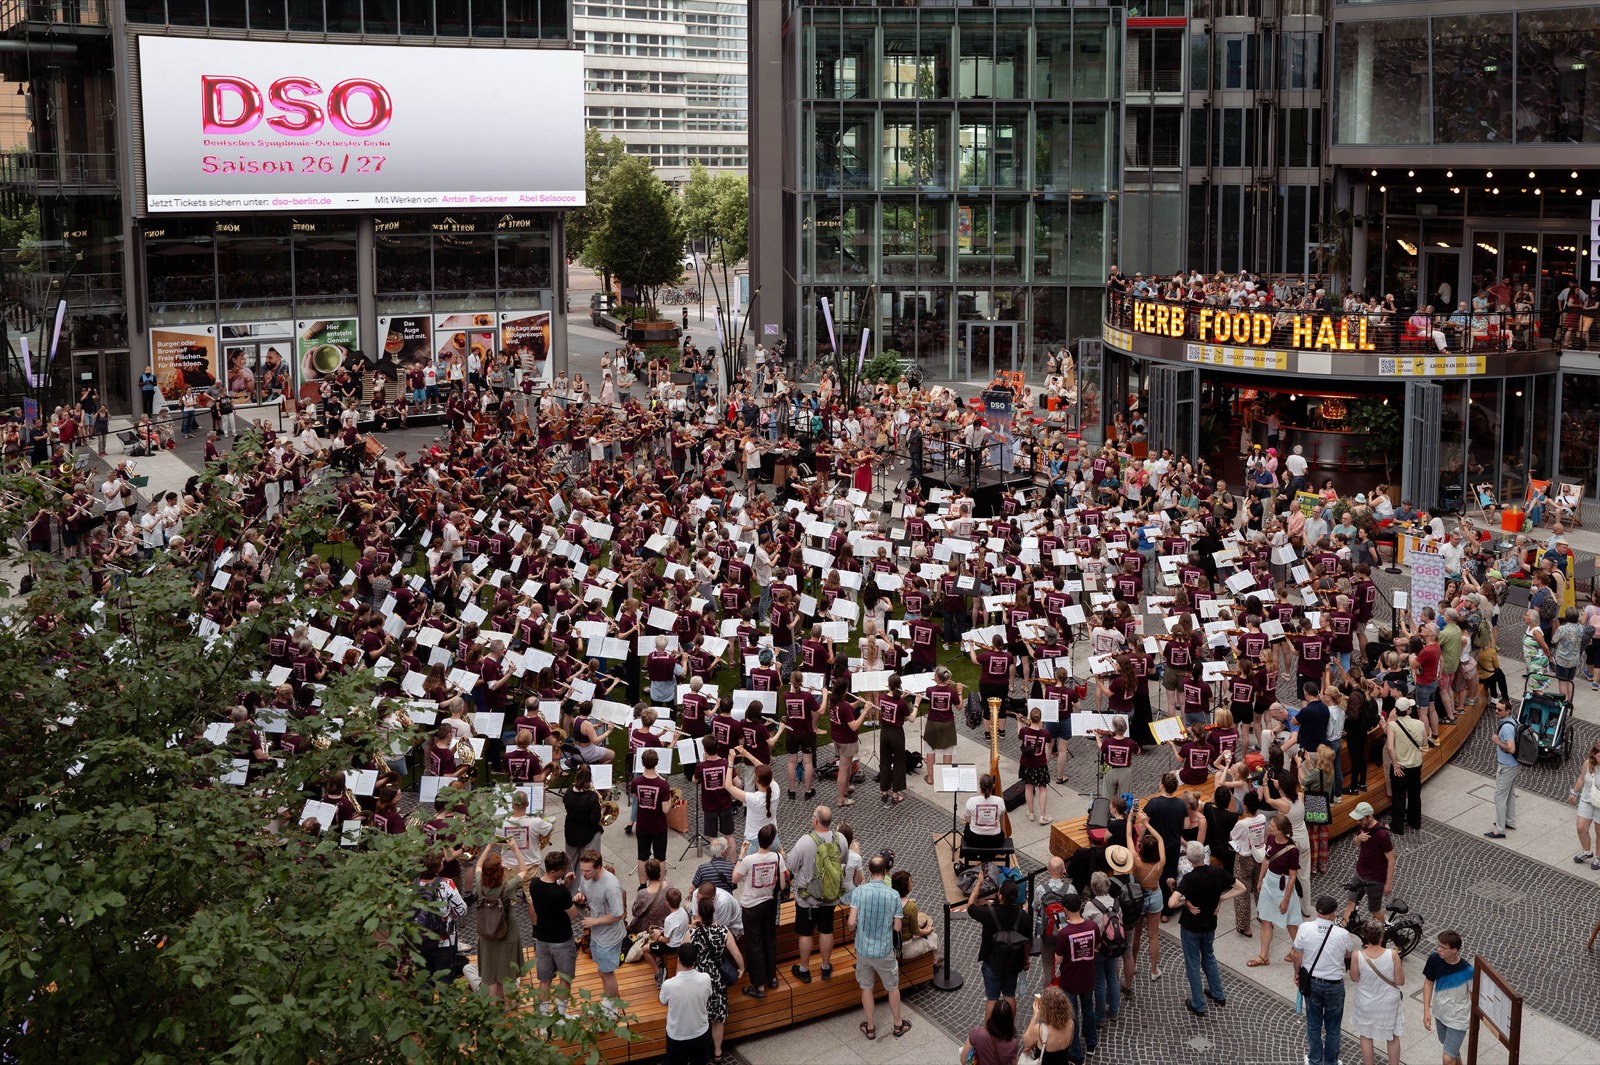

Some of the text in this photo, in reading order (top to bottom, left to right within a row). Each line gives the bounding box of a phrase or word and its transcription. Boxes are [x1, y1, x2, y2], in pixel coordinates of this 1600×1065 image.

[201, 74, 393, 136] DSO
[202, 153, 387, 176] Saison 26 / 27
[149, 198, 173, 208] Jetzt
[174, 198, 207, 207] Tickets
[208, 198, 242, 207] sichern
[244, 198, 270, 206] unter:
[272, 197, 332, 206] dso-berlin.de
[374, 196, 389, 204] Mit
[391, 195, 421, 204] Werken
[441, 195, 468, 203] Anton
[469, 195, 508, 203] Bruckner
[519, 194, 538, 203] Abel
[539, 194, 577, 203] Selaocoe
[1133, 301, 1376, 351] KERB FOOD HALL
[990, 401, 1005, 409] DSO
[1306, 811, 1327, 820] DSO
